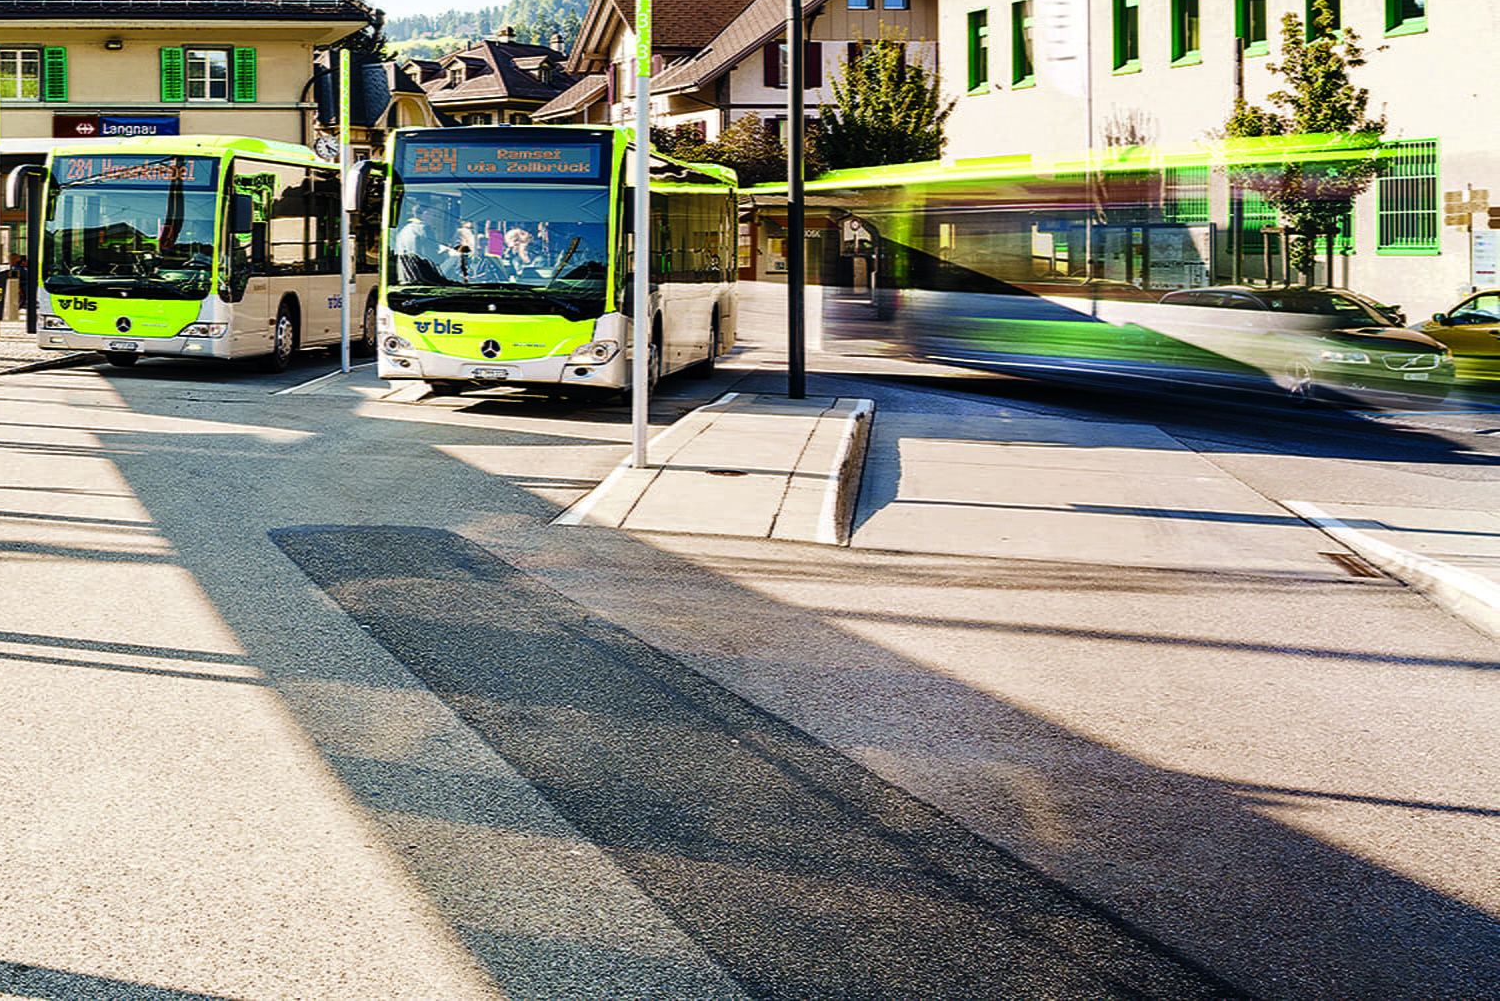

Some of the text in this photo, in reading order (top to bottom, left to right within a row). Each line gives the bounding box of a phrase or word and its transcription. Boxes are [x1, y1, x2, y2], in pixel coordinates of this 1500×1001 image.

[638, 13, 648, 28] 3
[638, 44, 648, 59] 3
[102, 122, 157, 136] Langnau
[414, 147, 458, 173] 284
[496, 148, 562, 160] Ramsei
[67, 158, 93, 180] 281
[466, 161, 591, 173] via Zollbrück
[73, 297, 98, 312] bls
[433, 318, 463, 335] bls
